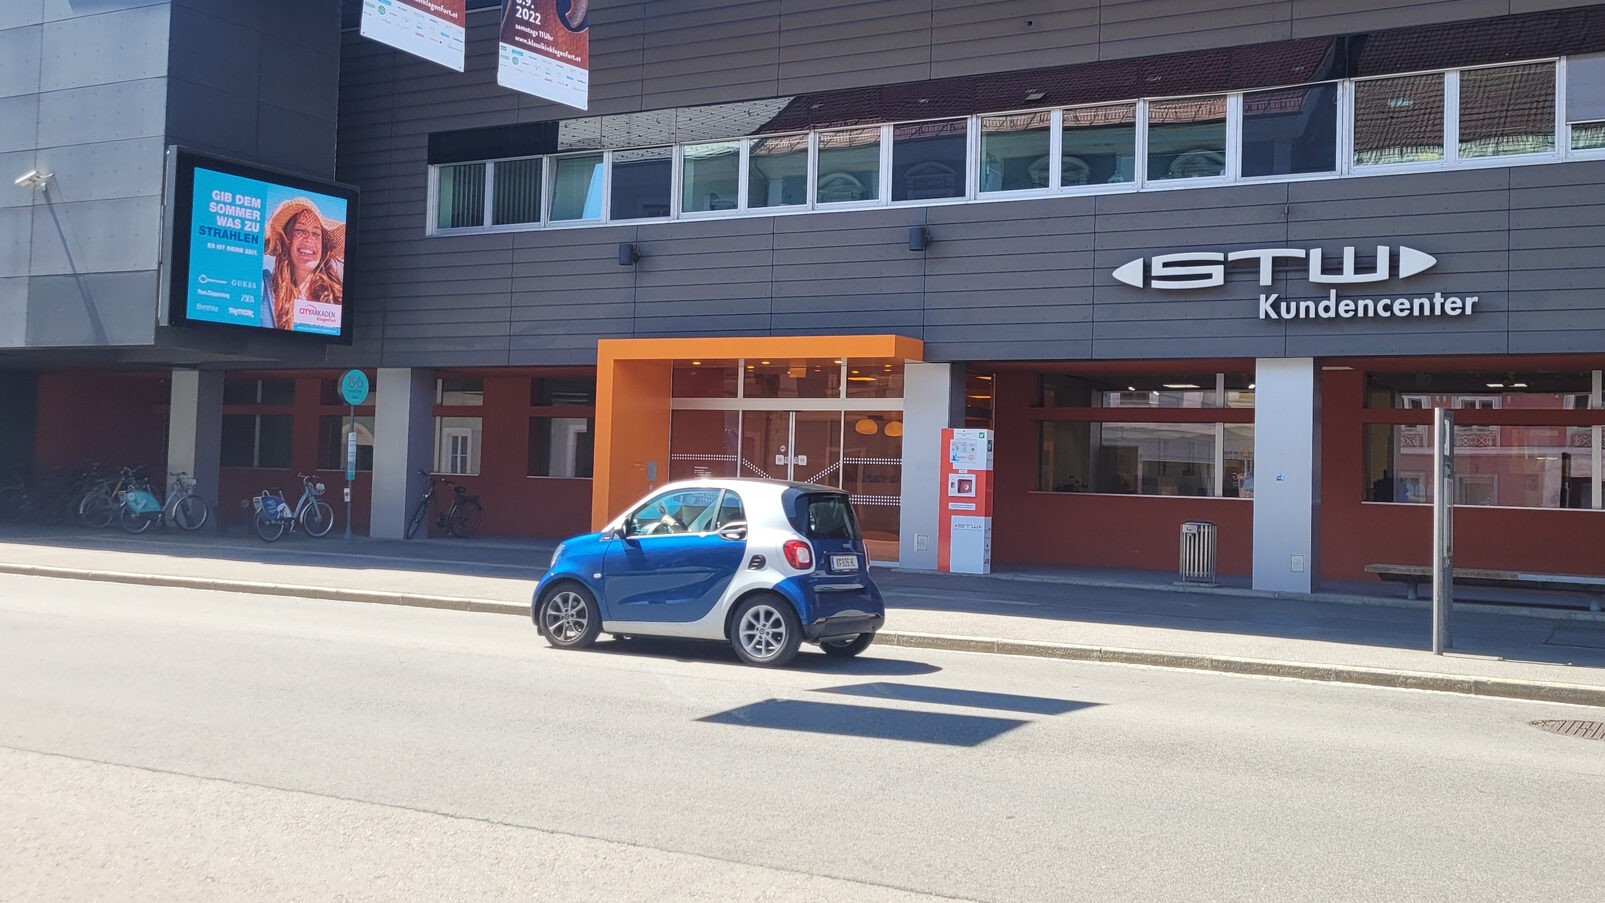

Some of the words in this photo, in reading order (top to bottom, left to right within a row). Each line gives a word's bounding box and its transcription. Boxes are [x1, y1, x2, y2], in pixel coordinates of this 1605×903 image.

[515, 5, 541, 26] 2022
[515, 24, 538, 38] samstags
[514, 35, 582, 62] www.klassikinklagenfurt.at
[211, 189, 233, 203] GIB
[235, 194, 262, 209] DEM
[209, 202, 261, 221] SOMMER
[216, 215, 242, 230] WAS
[244, 220, 260, 233] ZU
[198, 224, 259, 245] STRAHLEN
[231, 279, 257, 289] GUESS
[1259, 288, 1479, 320] Kundencenter
